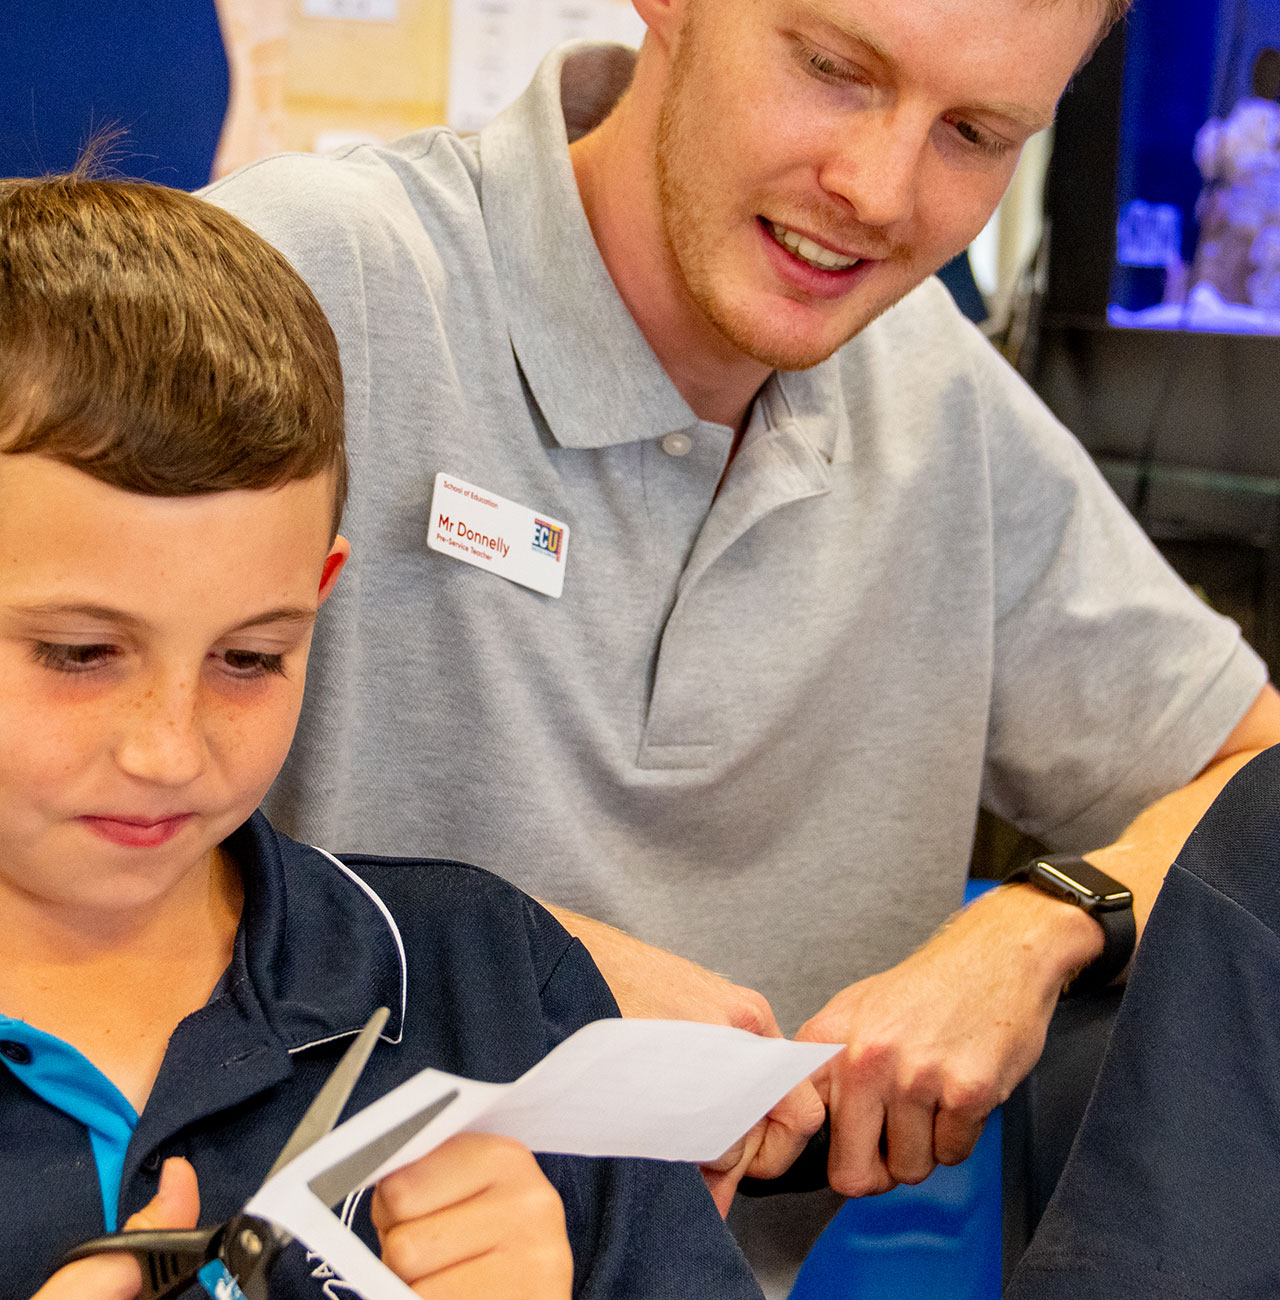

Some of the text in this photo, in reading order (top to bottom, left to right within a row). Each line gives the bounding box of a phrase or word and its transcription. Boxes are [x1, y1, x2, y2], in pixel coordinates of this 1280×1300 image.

[444, 480, 463, 493] School
[470, 492, 498, 509] Education
[438, 513, 455, 533] Mr
[457, 521, 510, 559] Donnelly
[532, 523, 558, 552] ECU
[471, 546, 492, 560] Teacher
